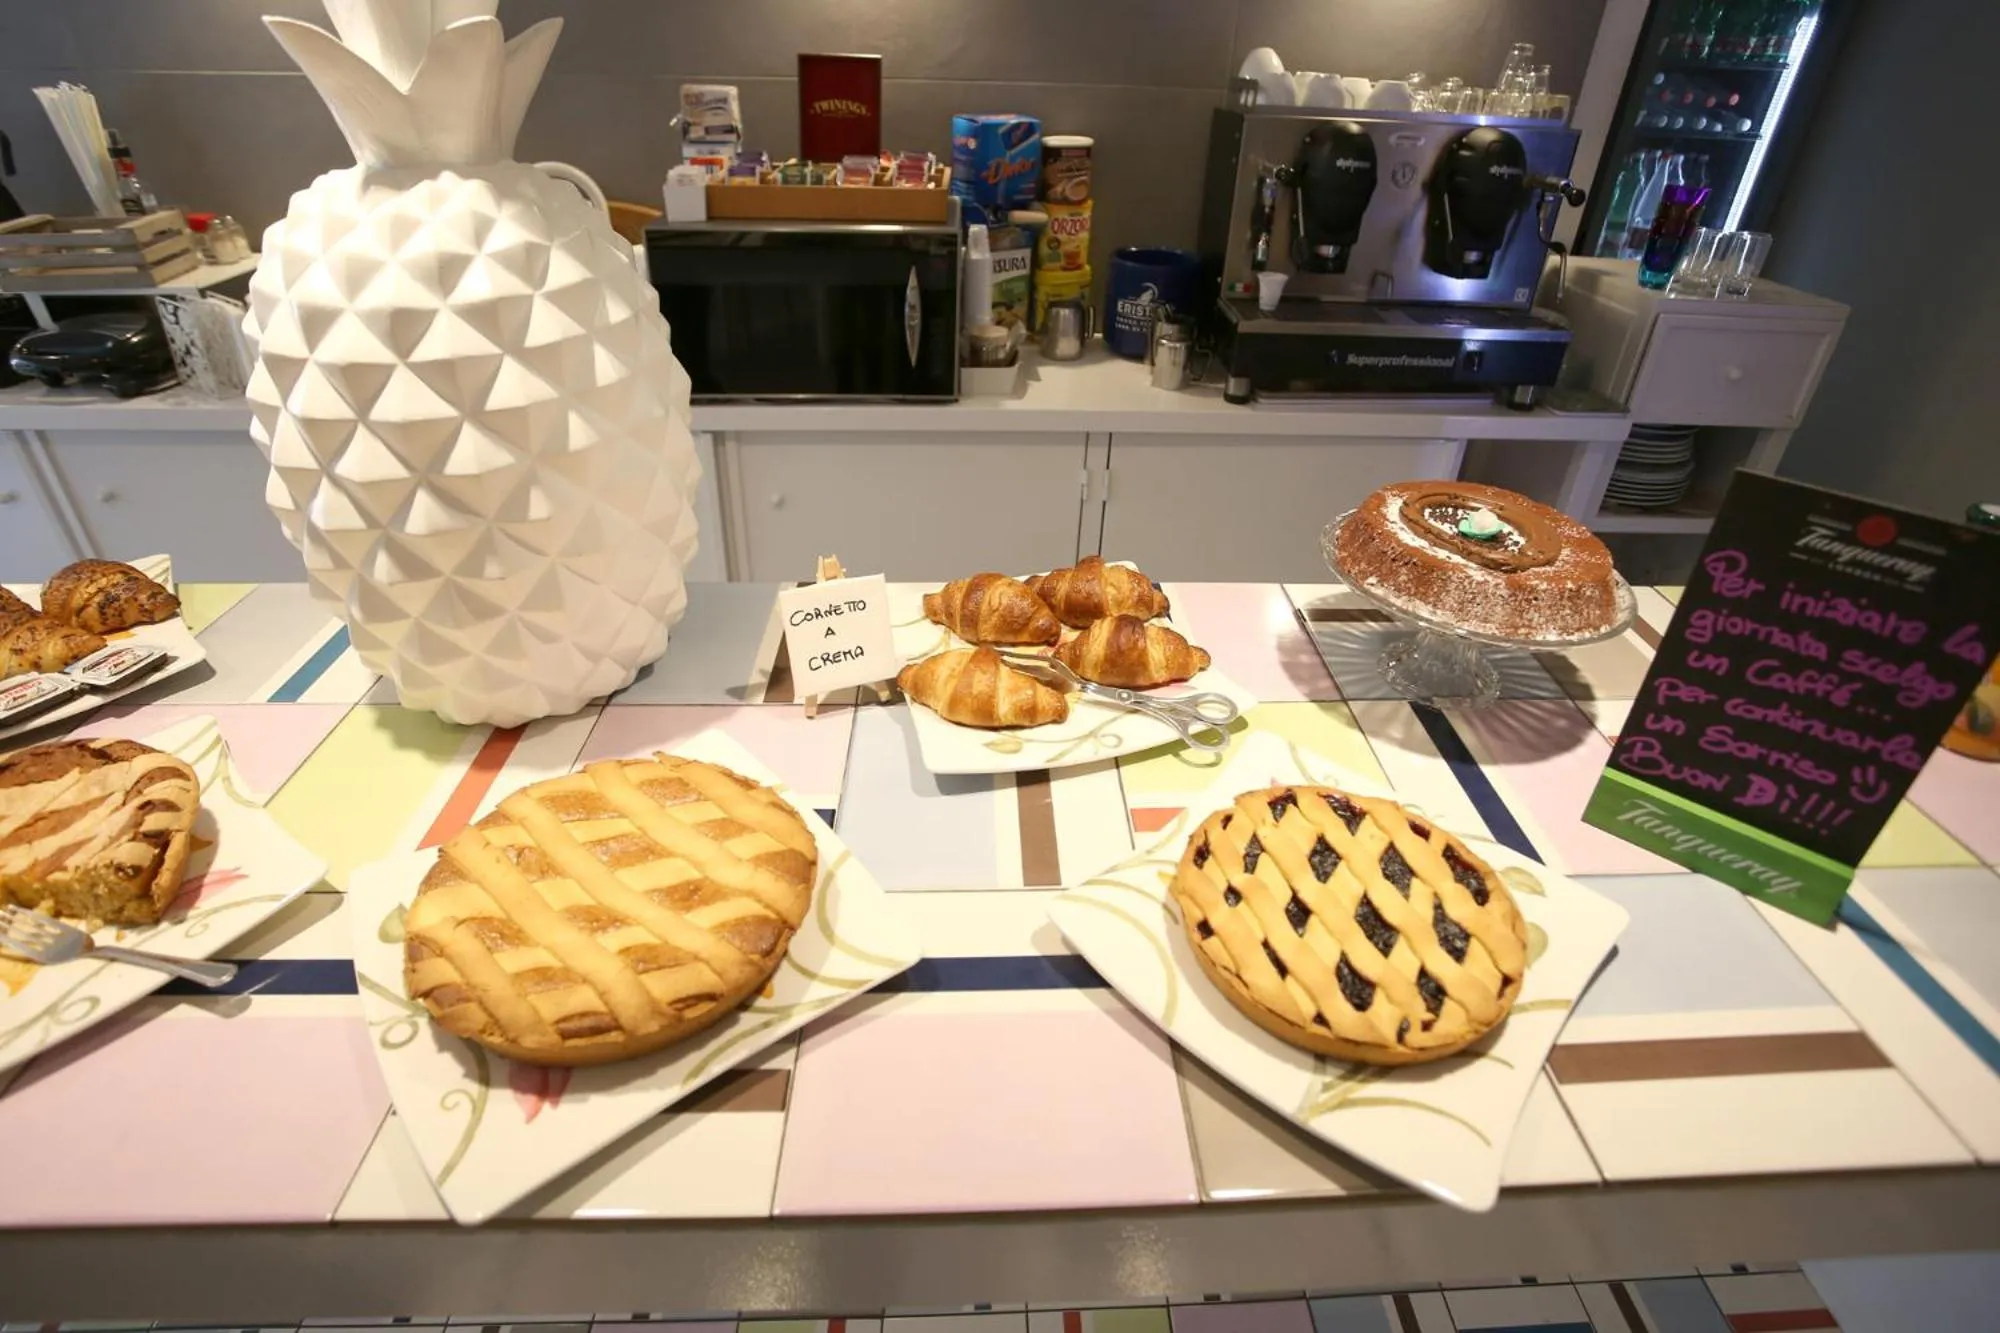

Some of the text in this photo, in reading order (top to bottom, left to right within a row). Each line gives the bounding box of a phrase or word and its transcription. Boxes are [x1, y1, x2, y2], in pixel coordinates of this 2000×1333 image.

[812, 98, 869, 116] TWININGS
[1346, 353, 1456, 367] Superprofessional
[1795, 524, 1938, 582] Tanqueray
[1704, 549, 1766, 598] Per
[790, 600, 867, 627] CORNETTO
[823, 626, 836, 639] A
[1684, 607, 1828, 662] giornata
[808, 645, 865, 672] CREMA
[1687, 648, 1730, 676] un
[1645, 712, 1686, 736] un
[1616, 799, 1806, 897] Tanqueray
